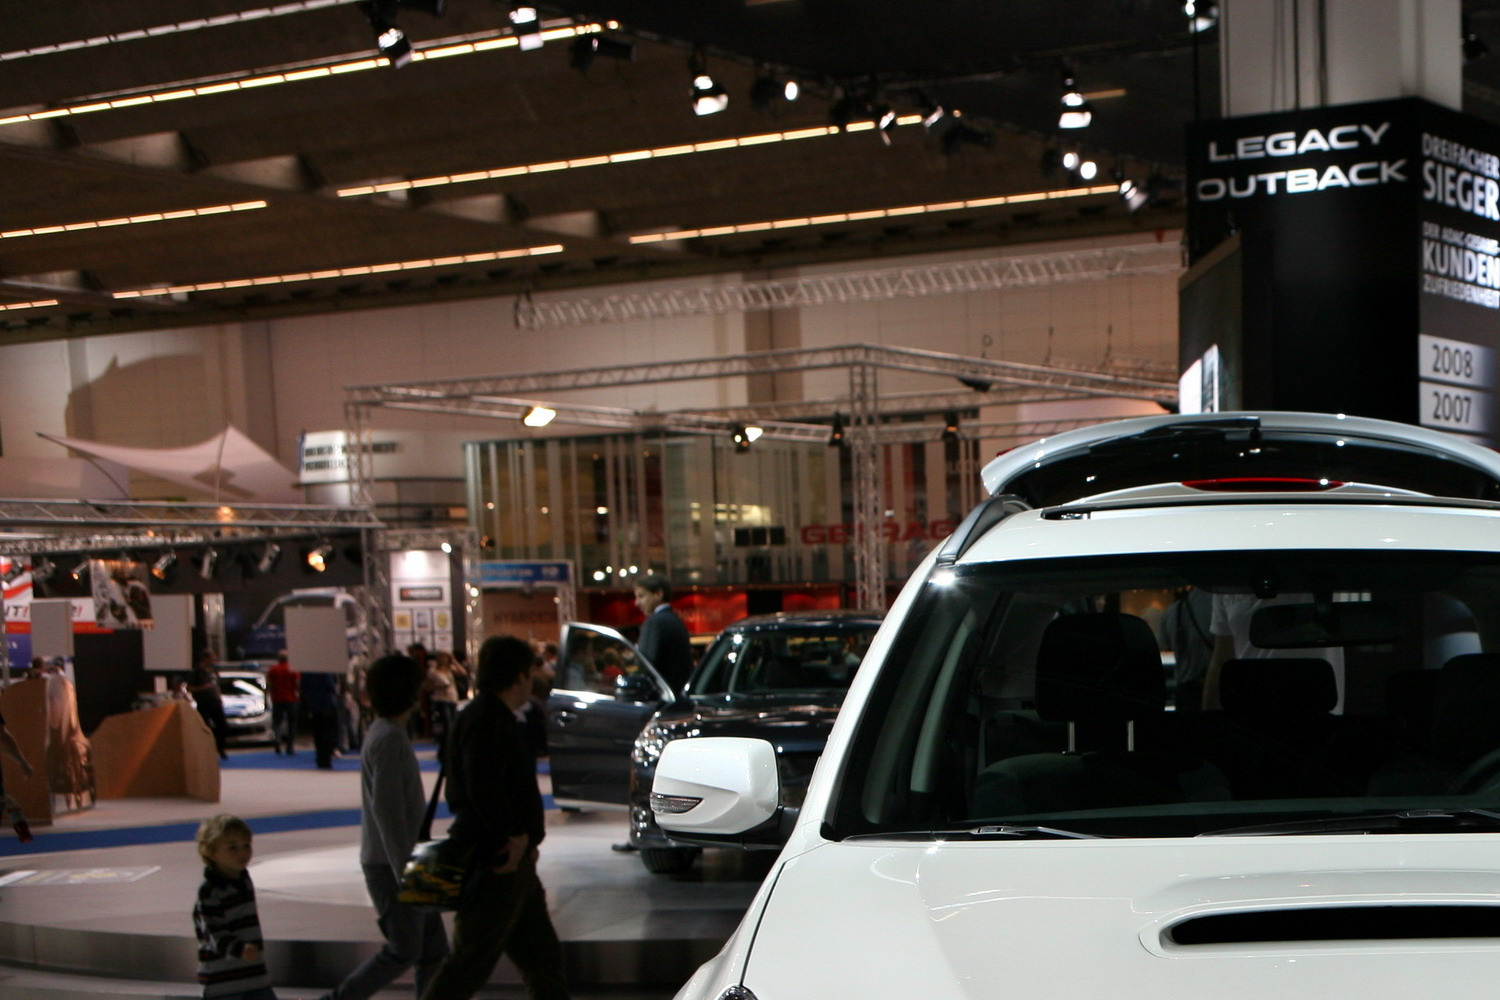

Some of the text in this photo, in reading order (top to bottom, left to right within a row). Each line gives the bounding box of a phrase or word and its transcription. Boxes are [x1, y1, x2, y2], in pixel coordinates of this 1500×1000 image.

[1208, 122, 1391, 163] LEGACY
[1421, 132, 1500, 180] DREIFACHER
[1199, 159, 1408, 200] OUTBACK
[1422, 159, 1500, 221] SIEGER
[1422, 240, 1500, 289] KUNDEN
[1432, 344, 1473, 378] 2008
[1432, 391, 1471, 424] 2007
